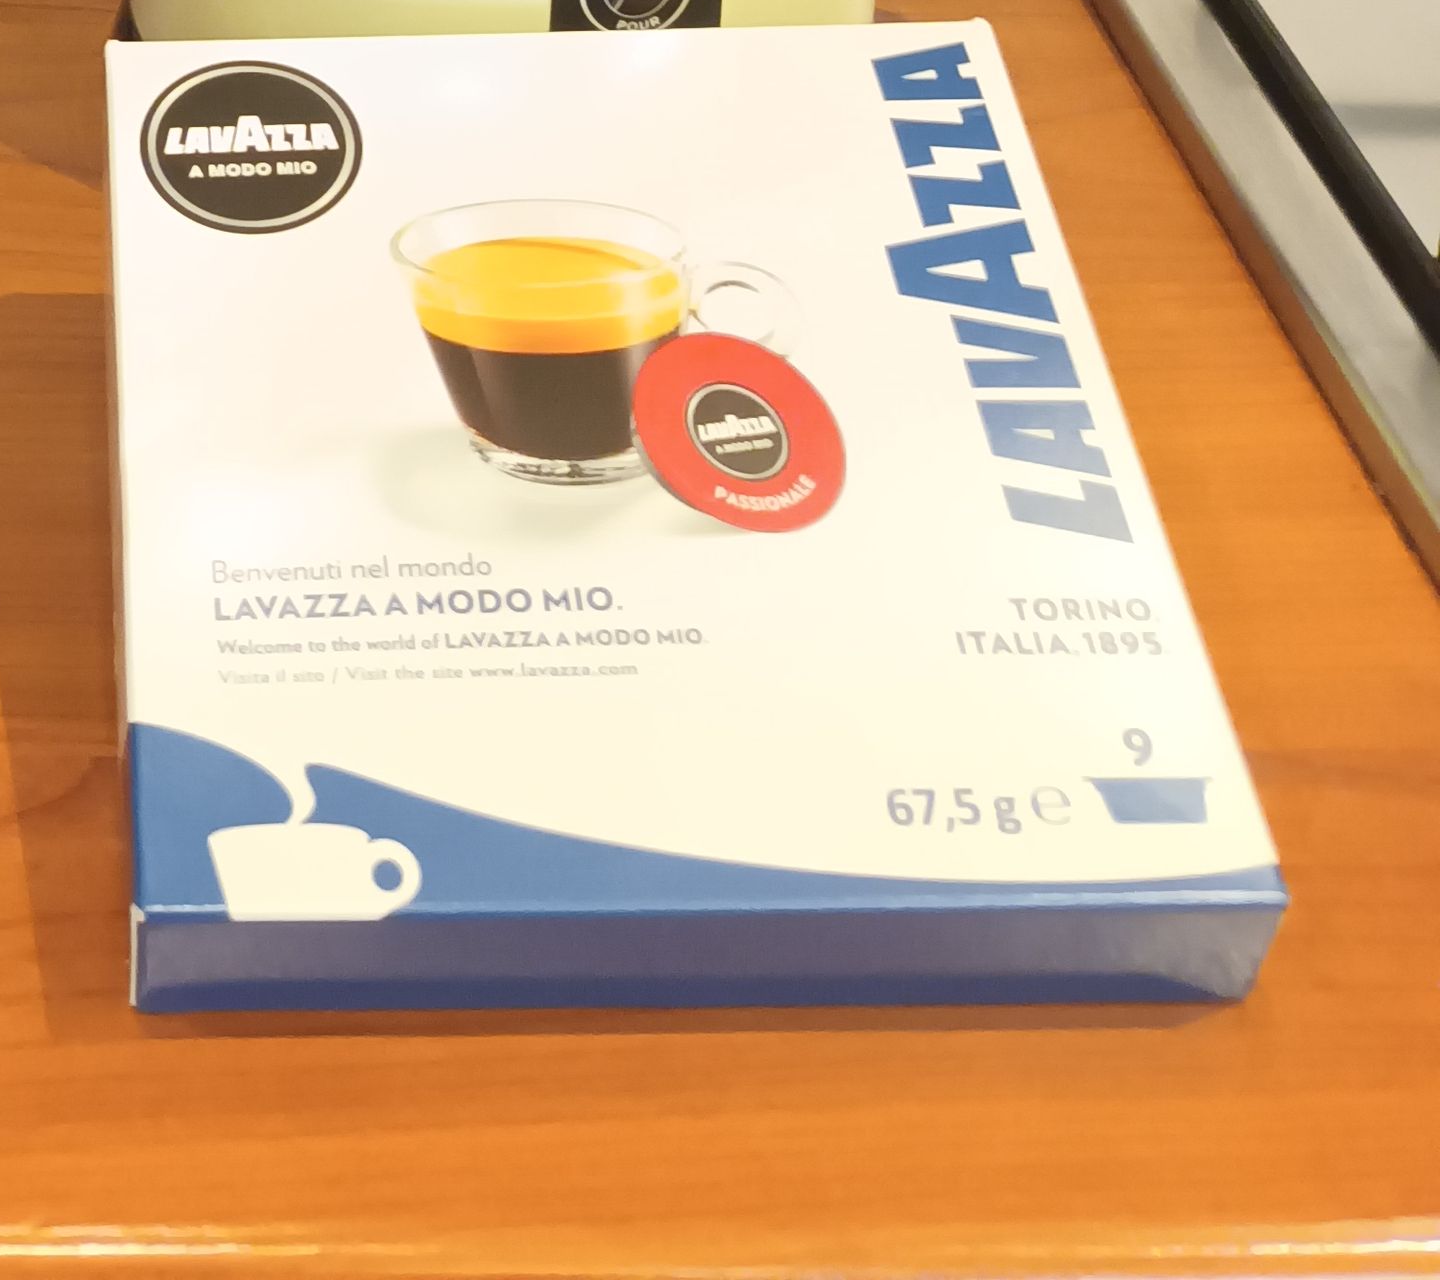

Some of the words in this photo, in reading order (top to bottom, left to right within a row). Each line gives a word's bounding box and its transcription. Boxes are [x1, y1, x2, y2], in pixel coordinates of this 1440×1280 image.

[615, 15, 661, 31] POUR
[163, 114, 340, 155] LAVAZZA
[189, 164, 205, 179] A
[208, 162, 272, 178] MODO
[276, 160, 318, 176] MIO
[871, 41, 1135, 544] LAVAZZA
[713, 473, 818, 512] PASSIONALE
[211, 558, 342, 584] Benvenuti
[351, 554, 390, 579] nel
[398, 551, 493, 578] mondo
[213, 591, 378, 621] LAVAZZA
[384, 591, 409, 616] A
[416, 587, 533, 616] MODO
[542, 585, 624, 613] MIO.
[216, 639, 303, 655] Welcome
[308, 638, 327, 653] to
[331, 636, 362, 652] the
[366, 634, 417, 651] world
[421, 632, 440, 650] of
[444, 630, 551, 649] LAVAZZA
[556, 631, 572, 647] A
[575, 627, 651, 647] MODO
[395, 664, 426, 680] the
[1121, 726, 1153, 767] 9
[885, 787, 982, 834] 67,5
[992, 795, 1024, 835] g
